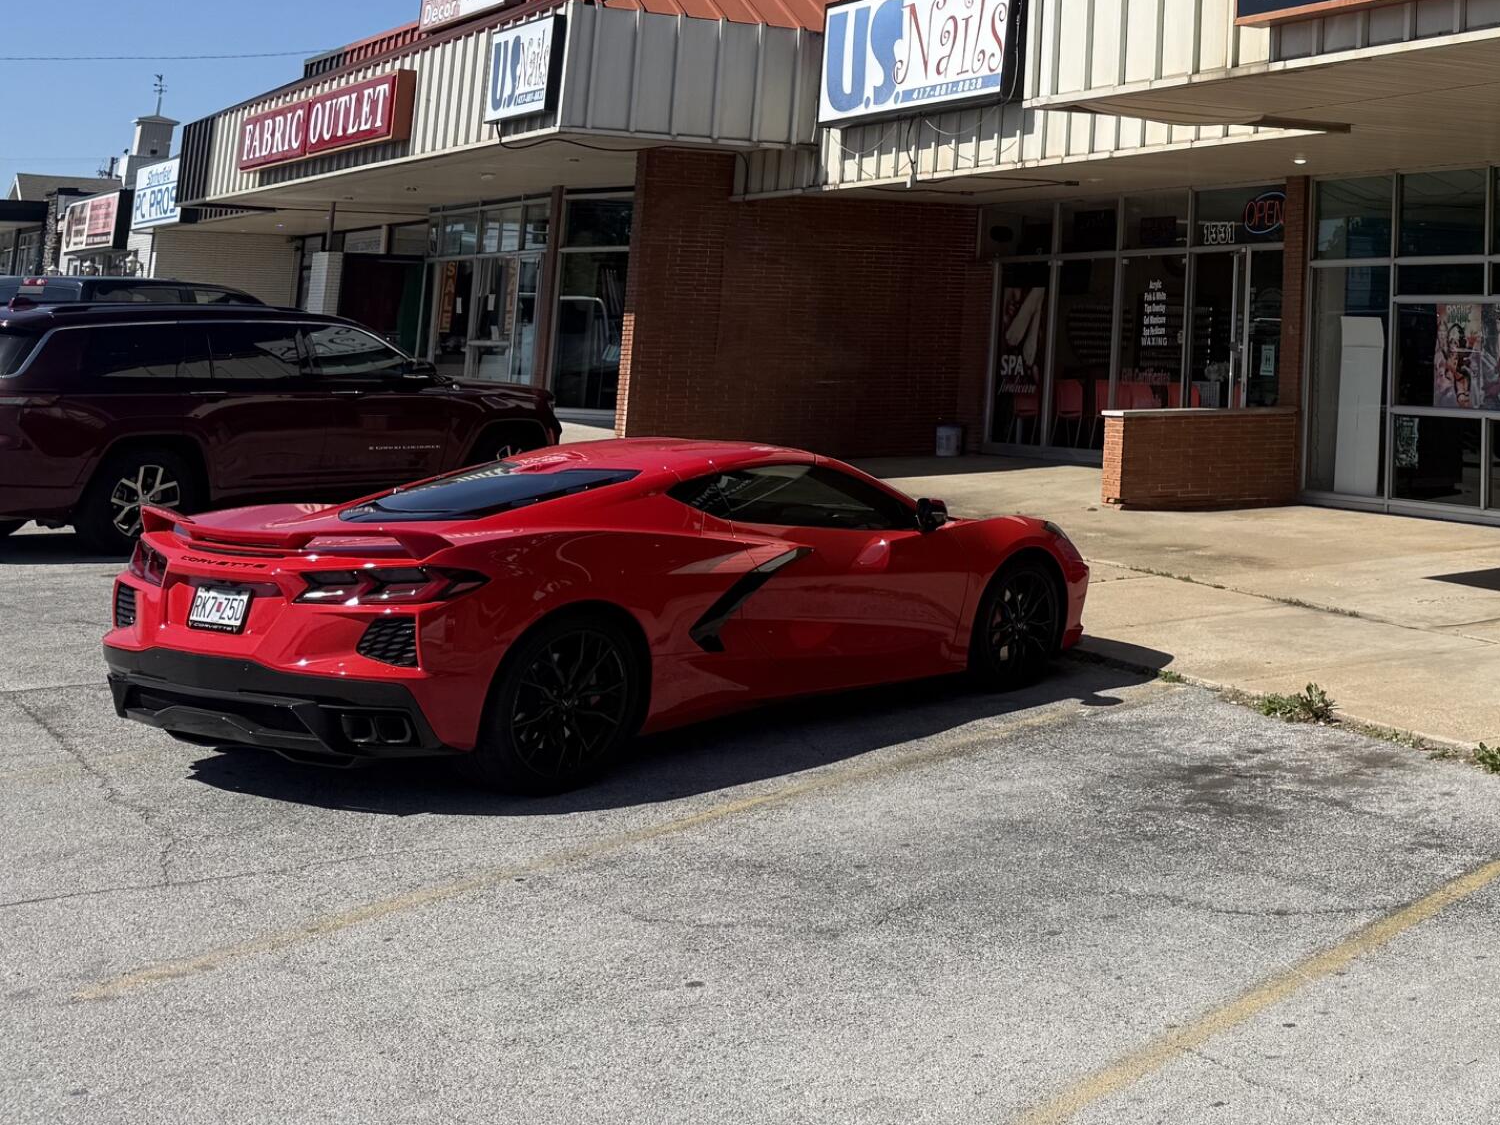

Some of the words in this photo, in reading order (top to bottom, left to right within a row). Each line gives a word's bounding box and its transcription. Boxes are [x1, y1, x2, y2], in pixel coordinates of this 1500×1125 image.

[424, 0, 458, 24] Decor
[242, 108, 304, 161] FABRIC
[309, 83, 389, 144] OUTLET
[134, 190, 146, 221] PC
[148, 185, 177, 219] PROS
[1245, 200, 1286, 227] OPEN
[1204, 221, 1235, 245] 1331
[440, 261, 457, 333] SALE
[1141, 336, 1168, 347] WAXING
[1000, 354, 1024, 375] SPA
[181, 555, 268, 569] CORVETTE
[191, 595, 217, 619] RK7
[218, 597, 245, 622] Z5D
[193, 622, 233, 631] CORVETTE
